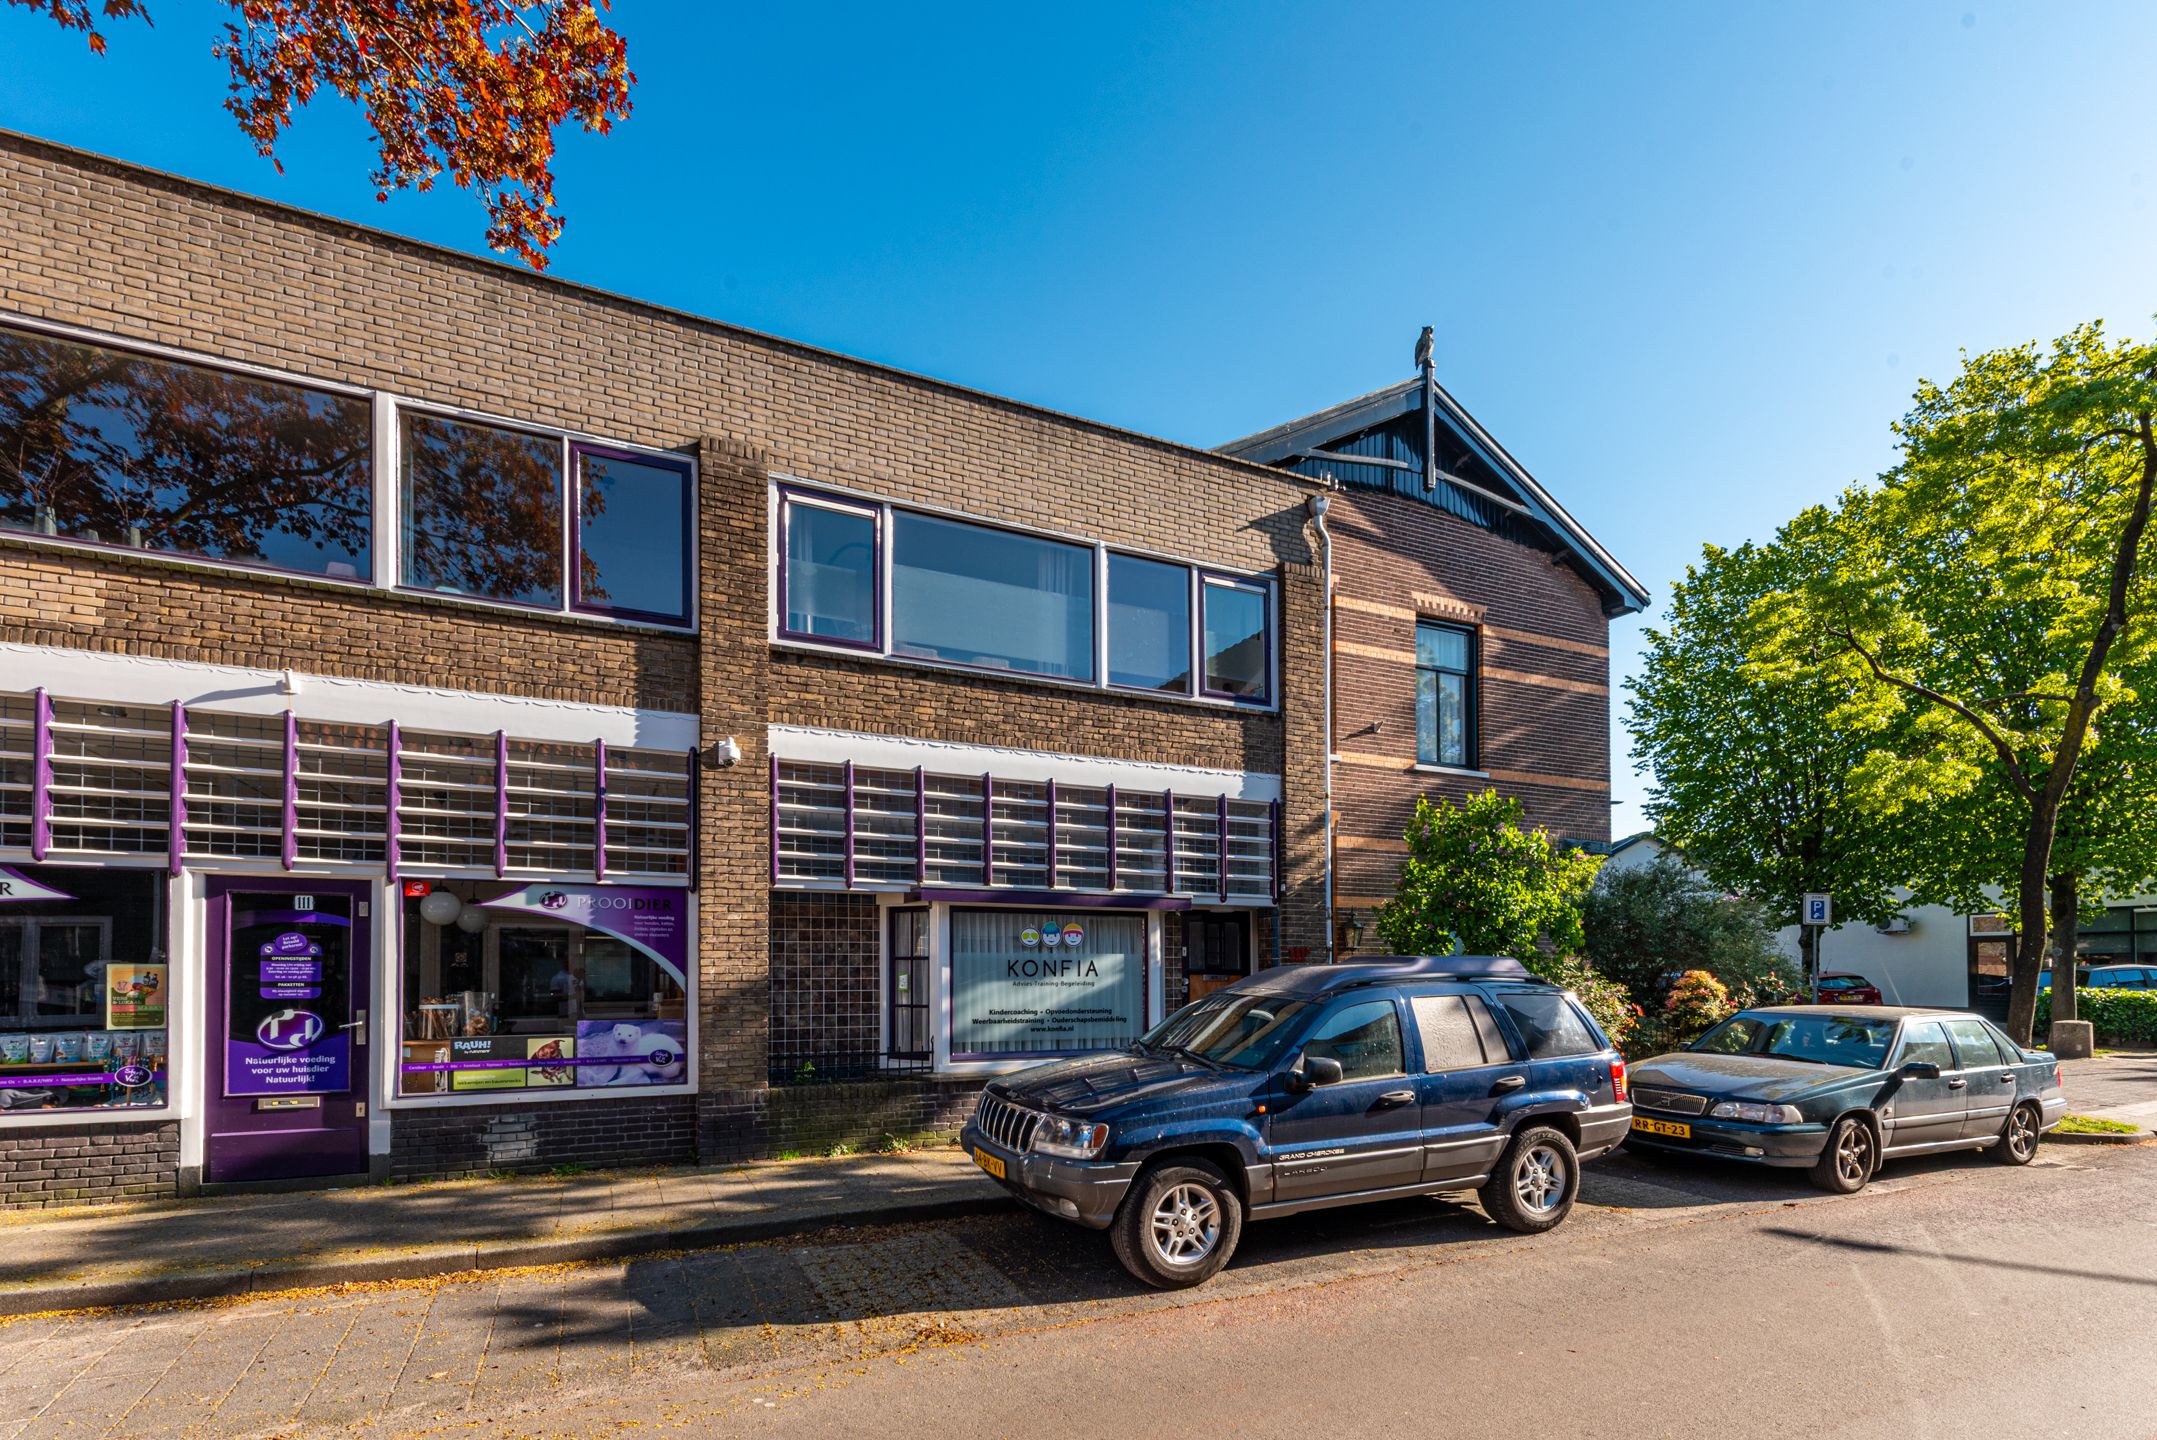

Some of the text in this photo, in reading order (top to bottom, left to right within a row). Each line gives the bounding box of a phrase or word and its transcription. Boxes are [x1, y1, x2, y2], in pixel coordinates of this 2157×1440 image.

[1007, 959, 1099, 977] KONFIA
[988, 1007, 1112, 1016] Kindercoaching Opvoedondersteuning
[972, 1015, 1127, 1025] Weerbaarheidstraining Ouderschapsbemiddeling
[1029, 1025, 1075, 1033] www.konfia.nl
[453, 1040, 492, 1050] RAUH!
[245, 1055, 336, 1065] Natuurlijke voeding
[292, 1065, 330, 1073] huisdier
[265, 1075, 315, 1084] Natuurlijk!
[1634, 1118, 1686, 1136] RR-GT-23
[1278, 1148, 1345, 1161] GRAND CHEROKEE
